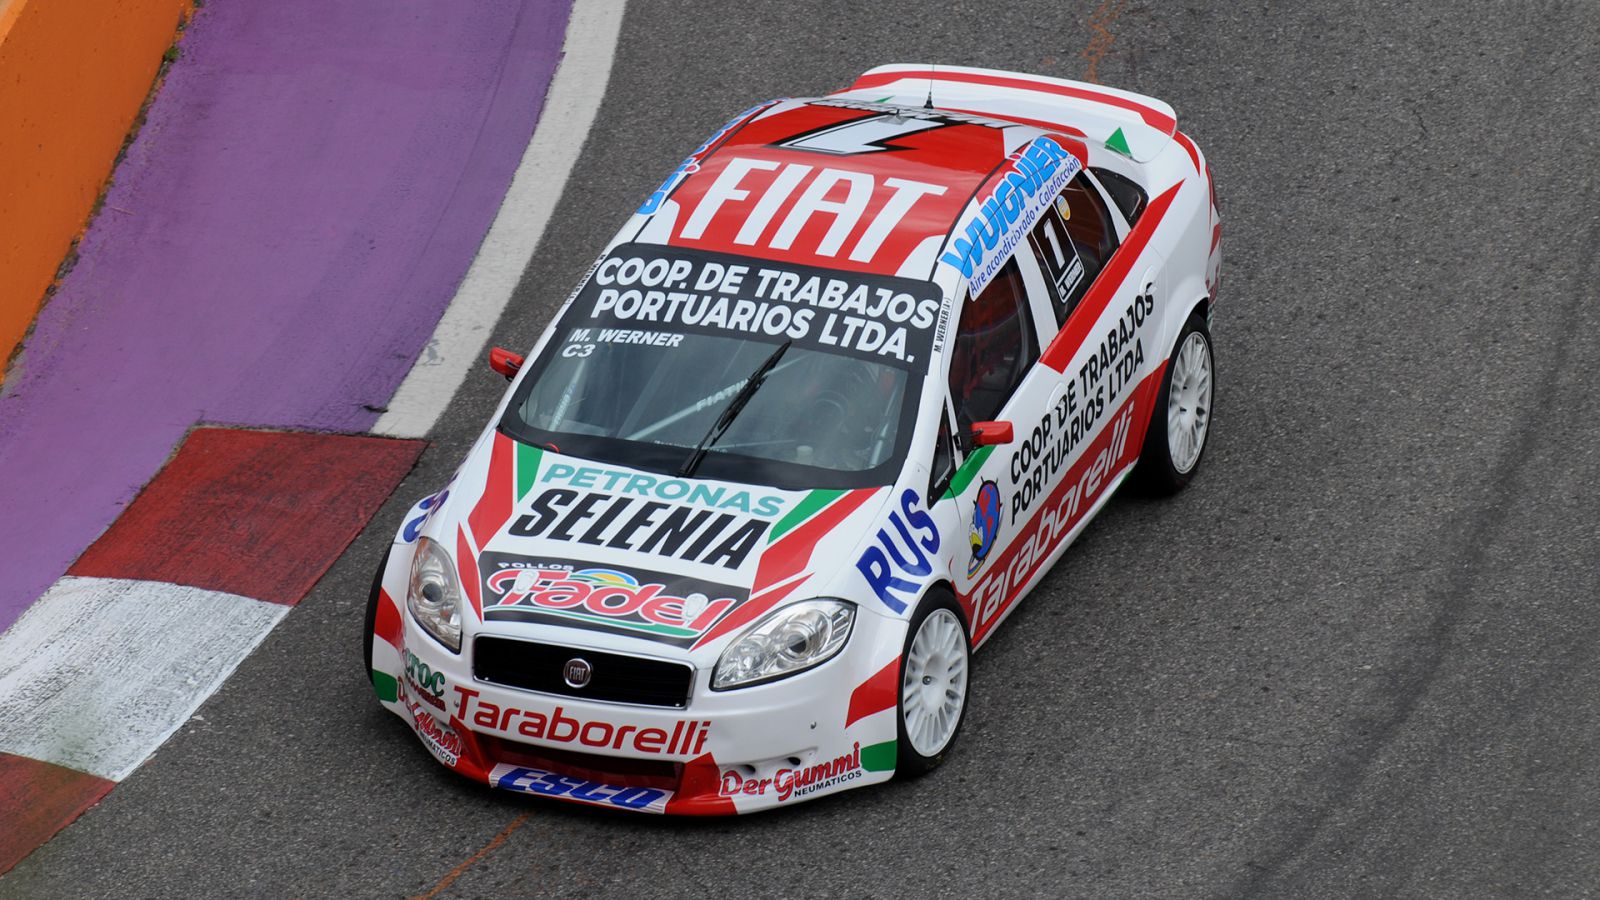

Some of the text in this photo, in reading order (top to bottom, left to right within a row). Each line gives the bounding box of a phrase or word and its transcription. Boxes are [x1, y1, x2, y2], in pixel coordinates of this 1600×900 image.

[679, 156, 949, 264] FIAT
[940, 136, 1071, 280] WUIGNIER
[1043, 217, 1066, 270] 1
[595, 257, 686, 291] COOP.
[694, 261, 749, 294] DE
[757, 268, 941, 329] TRABAJOS
[969, 271, 987, 297] Aire
[561, 344, 596, 358] C3
[568, 328, 684, 348] M. WERNER
[590, 289, 916, 364] PORTUARIOS LTDA.
[1010, 281, 1156, 485] COOP. DE TRABAJOS
[1011, 337, 1145, 527] PORTUARIOS LTDA
[540, 462, 786, 517] PETRONAS
[969, 401, 1136, 640] Taraborelli
[508, 488, 772, 571] SELENIA
[855, 488, 941, 616] RUS
[487, 567, 738, 630] Fadel
[497, 561, 575, 572] POLLOS
[569, 665, 586, 681] FIAT
[453, 684, 712, 757] Taraborelli
[497, 766, 667, 810] ESCO
[794, 769, 862, 798] NEUMATICOS
